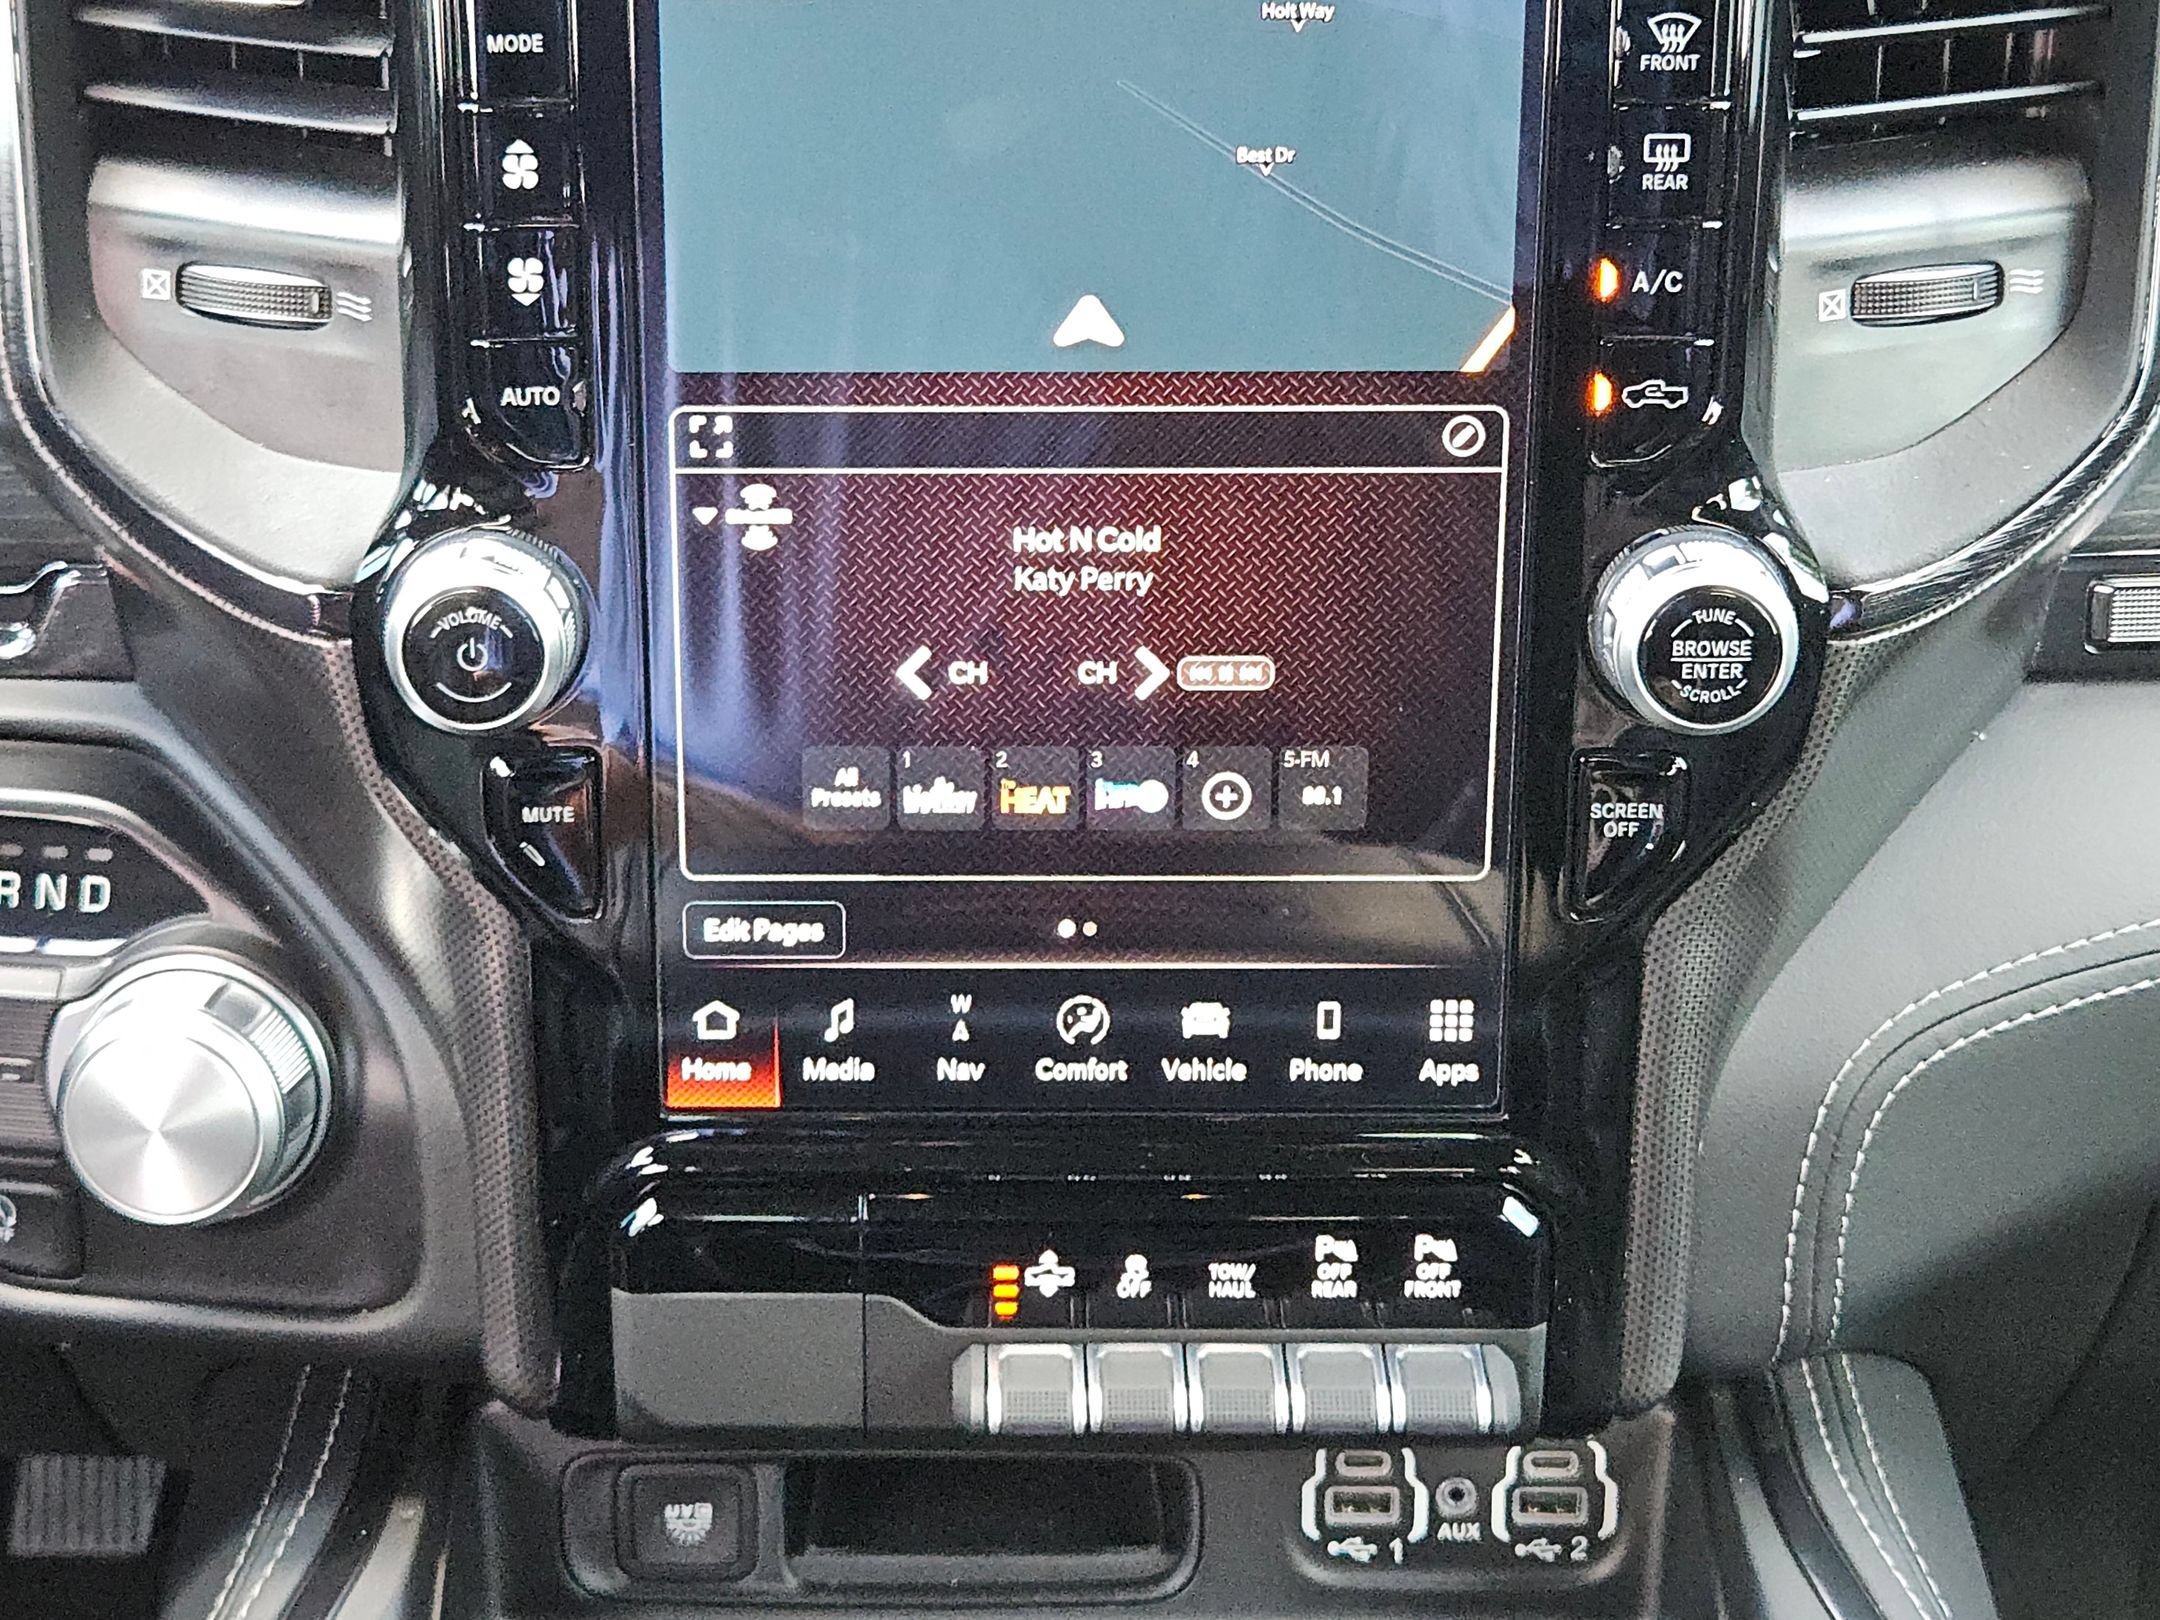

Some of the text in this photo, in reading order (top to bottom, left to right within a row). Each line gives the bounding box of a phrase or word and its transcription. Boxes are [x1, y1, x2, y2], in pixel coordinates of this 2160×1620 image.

[1261, 2, 1335, 22] Holt Way
[486, 33, 544, 53] MODE
[1640, 54, 1701, 72] FRONT
[1236, 146, 1296, 163] Best Dr
[1642, 173, 1689, 191] REAR
[1632, 268, 1684, 296] A/C
[500, 386, 560, 407] AUTO
[1012, 525, 1162, 552] Hot N Cold
[1014, 565, 1154, 597] Katy Perry
[437, 606, 502, 631] VOLUME
[1692, 608, 1736, 625] TUNE
[1671, 640, 1752, 657] BROWSE
[948, 660, 989, 685] CH
[1077, 660, 1117, 685] CH
[1681, 663, 1744, 680] ENTER
[1680, 684, 1741, 704] SCROLL
[903, 751, 912, 769] 1
[995, 751, 1008, 768] 2
[1090, 751, 1104, 768] 3
[1186, 751, 1199, 768] 4
[1283, 751, 1330, 768] 5-FM
[834, 766, 859, 787] All
[811, 788, 881, 808] Presets
[1000, 785, 1071, 814] HEAT
[521, 806, 575, 823] MUTE
[1590, 802, 1664, 819] SCREEN
[1603, 821, 1640, 838] OFF
[0, 870, 111, 913] R N D
[703, 917, 825, 947] Edit Pages
[681, 1057, 752, 1082] Home
[802, 1057, 876, 1082] Media
[936, 1057, 985, 1082] Nav
[1034, 1057, 1129, 1082] Comfort
[1160, 1057, 1248, 1082] Vehicle
[1289, 1057, 1364, 1082] Phone
[1418, 1057, 1480, 1087] Apps
[1208, 1263, 1256, 1281] TOW/
[1316, 1262, 1353, 1281] OFF
[1415, 1262, 1452, 1281] OFF
[1116, 1281, 1152, 1299] OFF
[1208, 1280, 1256, 1299] HAUL
[1311, 1280, 1358, 1299] REAR
[1404, 1280, 1462, 1299] FRONT
[1436, 1522, 1481, 1541] AUX
[1389, 1537, 1404, 1564] 1
[1570, 1535, 1588, 1562] 2
